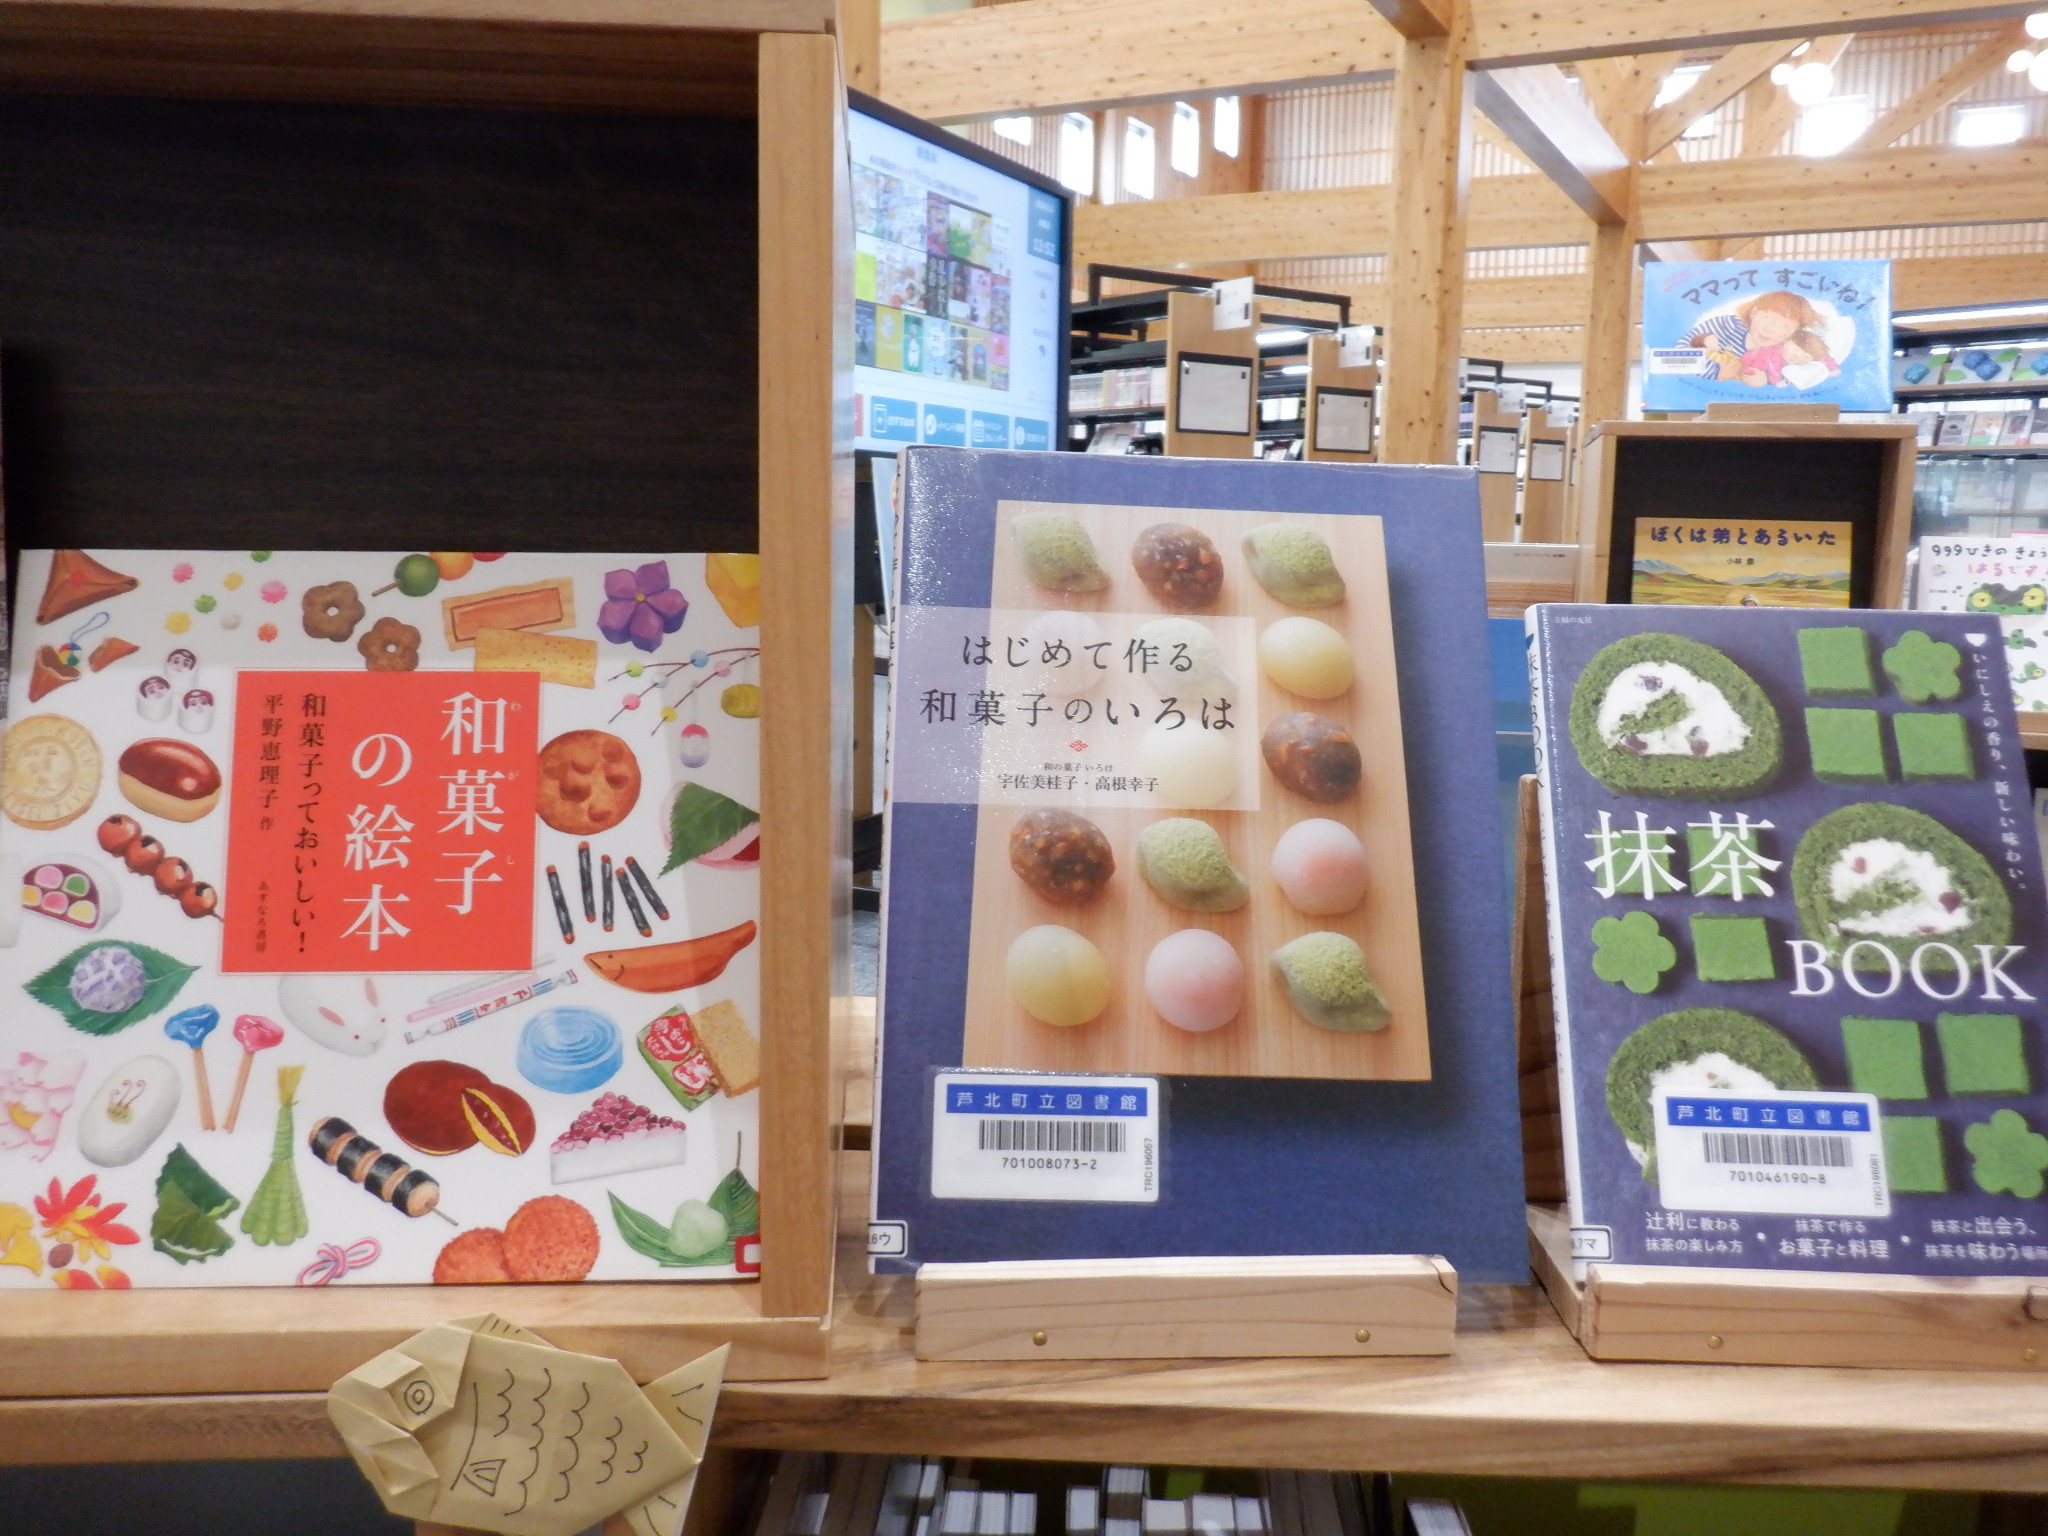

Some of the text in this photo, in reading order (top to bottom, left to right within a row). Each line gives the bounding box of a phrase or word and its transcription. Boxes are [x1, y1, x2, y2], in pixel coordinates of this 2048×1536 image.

[1681, 269, 1758, 305] ママって
[1651, 525, 1837, 547] ぼくは弟とあるいた
[1931, 544, 2007, 557] 999ひきの
[1968, 562, 2048, 577] はるです
[963, 634, 1195, 674] はじめて作る
[919, 688, 1236, 732] 和菓子のいろは
[434, 691, 508, 915] 和菓子
[340, 732, 416, 951] の絵本
[1584, 810, 1782, 901] 抹茶
[1785, 940, 2036, 1000] BOOK
[956, 1092, 1137, 1111] 芦北町立図書館
[1676, 1104, 1861, 1127] 芦北町立図書館
[1001, 1157, 1097, 1170] 701008073-2
[1729, 1170, 1826, 1185] 701046190-8
[1645, 1211, 1740, 1231] 辻利に教わる
[1795, 1218, 1866, 1233] 抹茶で作る
[1645, 1238, 1742, 1254] 抹茶の楽しみ方
[1779, 1238, 1889, 1258] お菓子と料理
